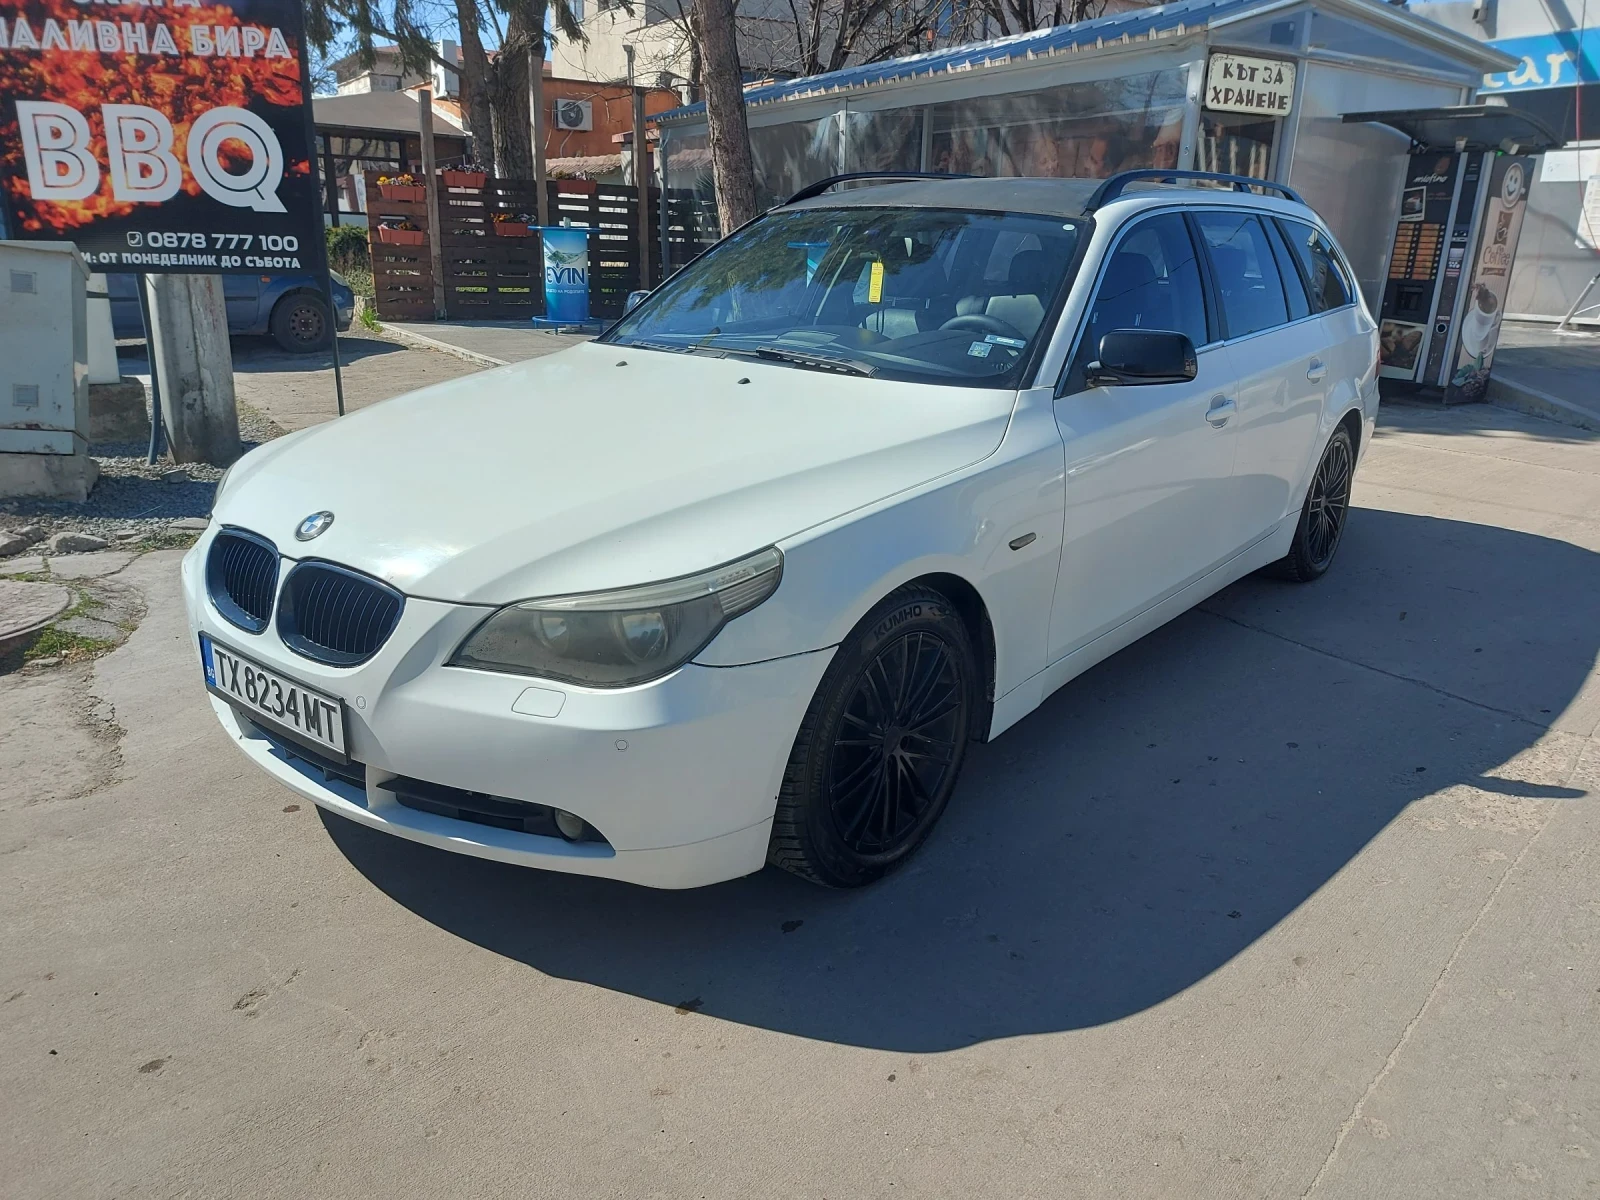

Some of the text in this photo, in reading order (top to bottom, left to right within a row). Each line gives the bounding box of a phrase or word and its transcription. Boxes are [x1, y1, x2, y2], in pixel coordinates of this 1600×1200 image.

[191, 25, 292, 59] БИРА
[1223, 62, 1284, 84] КЪТ ЗА
[1211, 86, 1288, 110] ХРАНЕНЕ
[15, 100, 288, 213] BBQ
[147, 231, 298, 252] 0878 777 100
[99, 252, 118, 264] ОТ
[122, 253, 217, 267] ПОНЕДЕЛНИК
[220, 255, 241, 268] ДО
[245, 257, 301, 269] СЪБОТА
[873, 604, 922, 640] KUMHO
